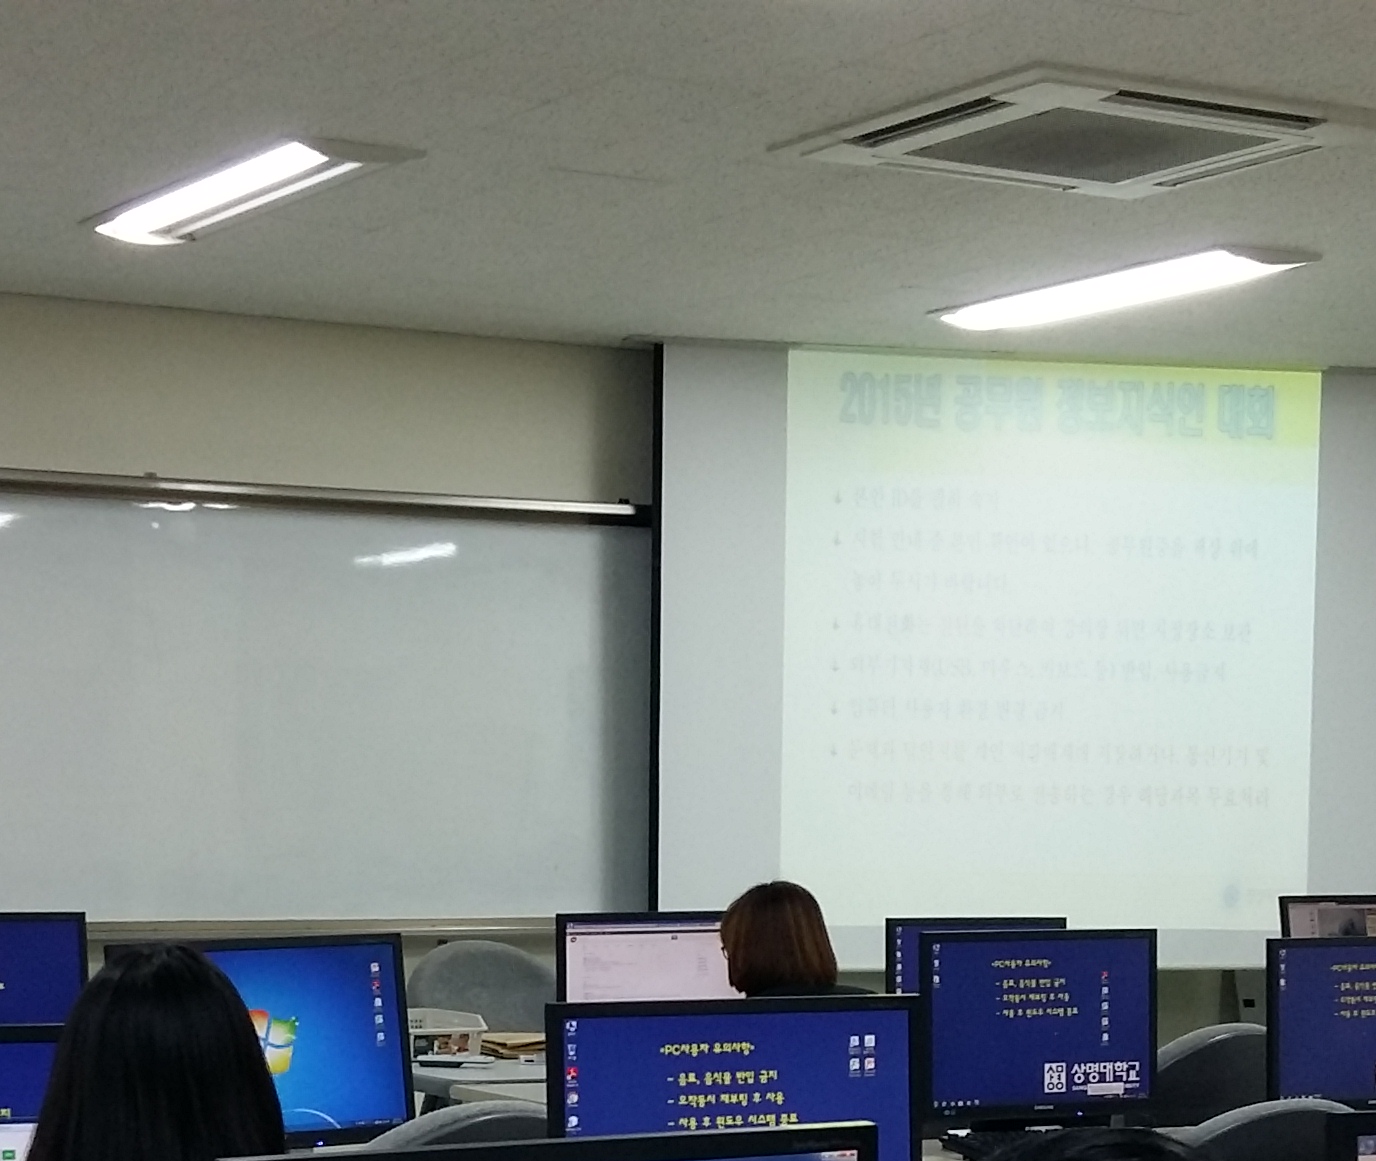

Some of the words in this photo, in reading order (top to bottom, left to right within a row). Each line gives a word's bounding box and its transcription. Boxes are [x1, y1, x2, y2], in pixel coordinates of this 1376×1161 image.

[838, 371, 941, 429] 2015년
[1056, 378, 1206, 439] 정보지식인
[1217, 383, 1276, 440] 대회
[678, 1073, 700, 1086] 음료,
[704, 1072, 732, 1085] 음식물
[736, 1071, 754, 1084] 반입
[759, 1070, 778, 1083] 금지
[1071, 1061, 1140, 1084] 상명대학교
[678, 1094, 716, 1108] 오작동시
[720, 1093, 748, 1106] 재부팅
[753, 1092, 762, 1102] 후
[766, 1091, 784, 1105] 사용
[679, 1117, 697, 1130] 사용
[702, 1116, 711, 1127] 후
[716, 1115, 743, 1129] 윈도우
[748, 1114, 776, 1127] 시스템
[780, 1113, 798, 1126] 종료
